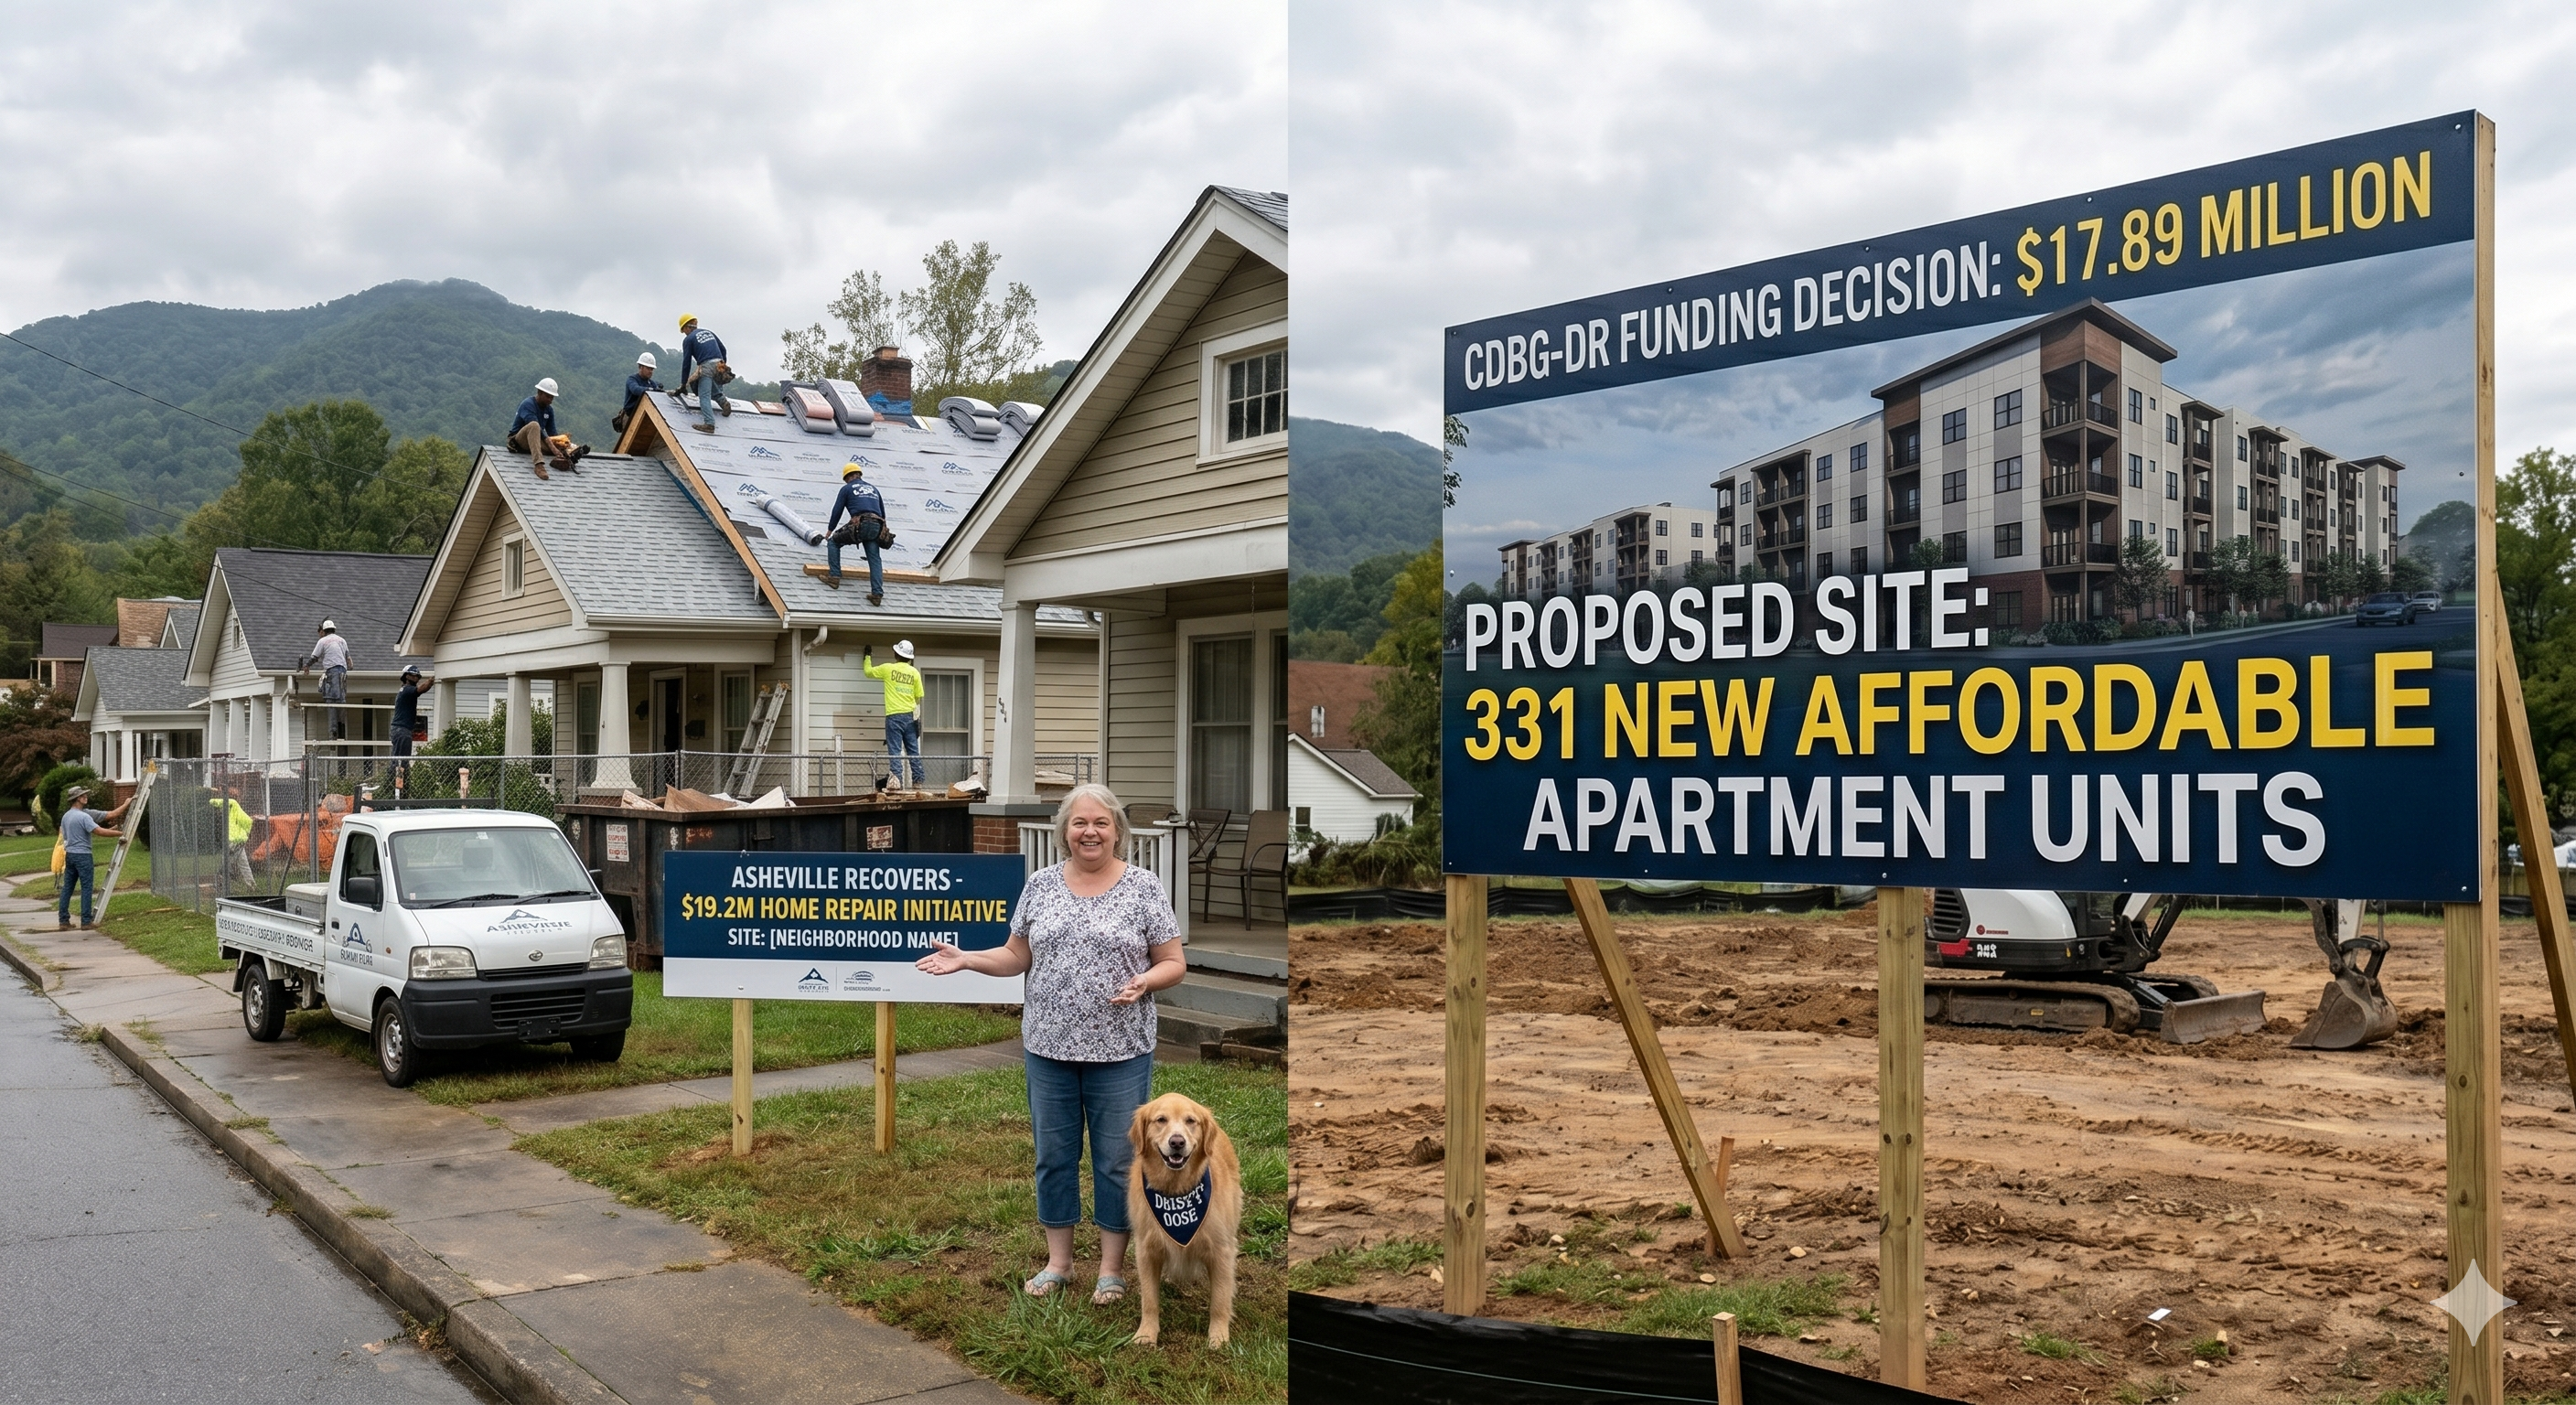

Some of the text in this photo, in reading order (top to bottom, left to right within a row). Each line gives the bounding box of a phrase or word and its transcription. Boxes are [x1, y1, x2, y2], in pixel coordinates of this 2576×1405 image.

[1464, 151, 2431, 392] CDBG-DR FUNDING DECISION: $17.89 MILLION
[1465, 567, 1990, 672] PROPOSED SITE:
[1464, 650, 2436, 762] 331 NEW AFFORDABLE
[1522, 771, 2326, 868] APARTMENT UNITS
[682, 893, 1007, 923] $19.2M HOME REPAIR INITIATIVE
[731, 865, 839, 890] ASHEVILLE
[844, 866, 951, 892] RECOVERS
[727, 928, 767, 947] SITE:
[769, 928, 904, 950] [NEIGHBORHOOD
